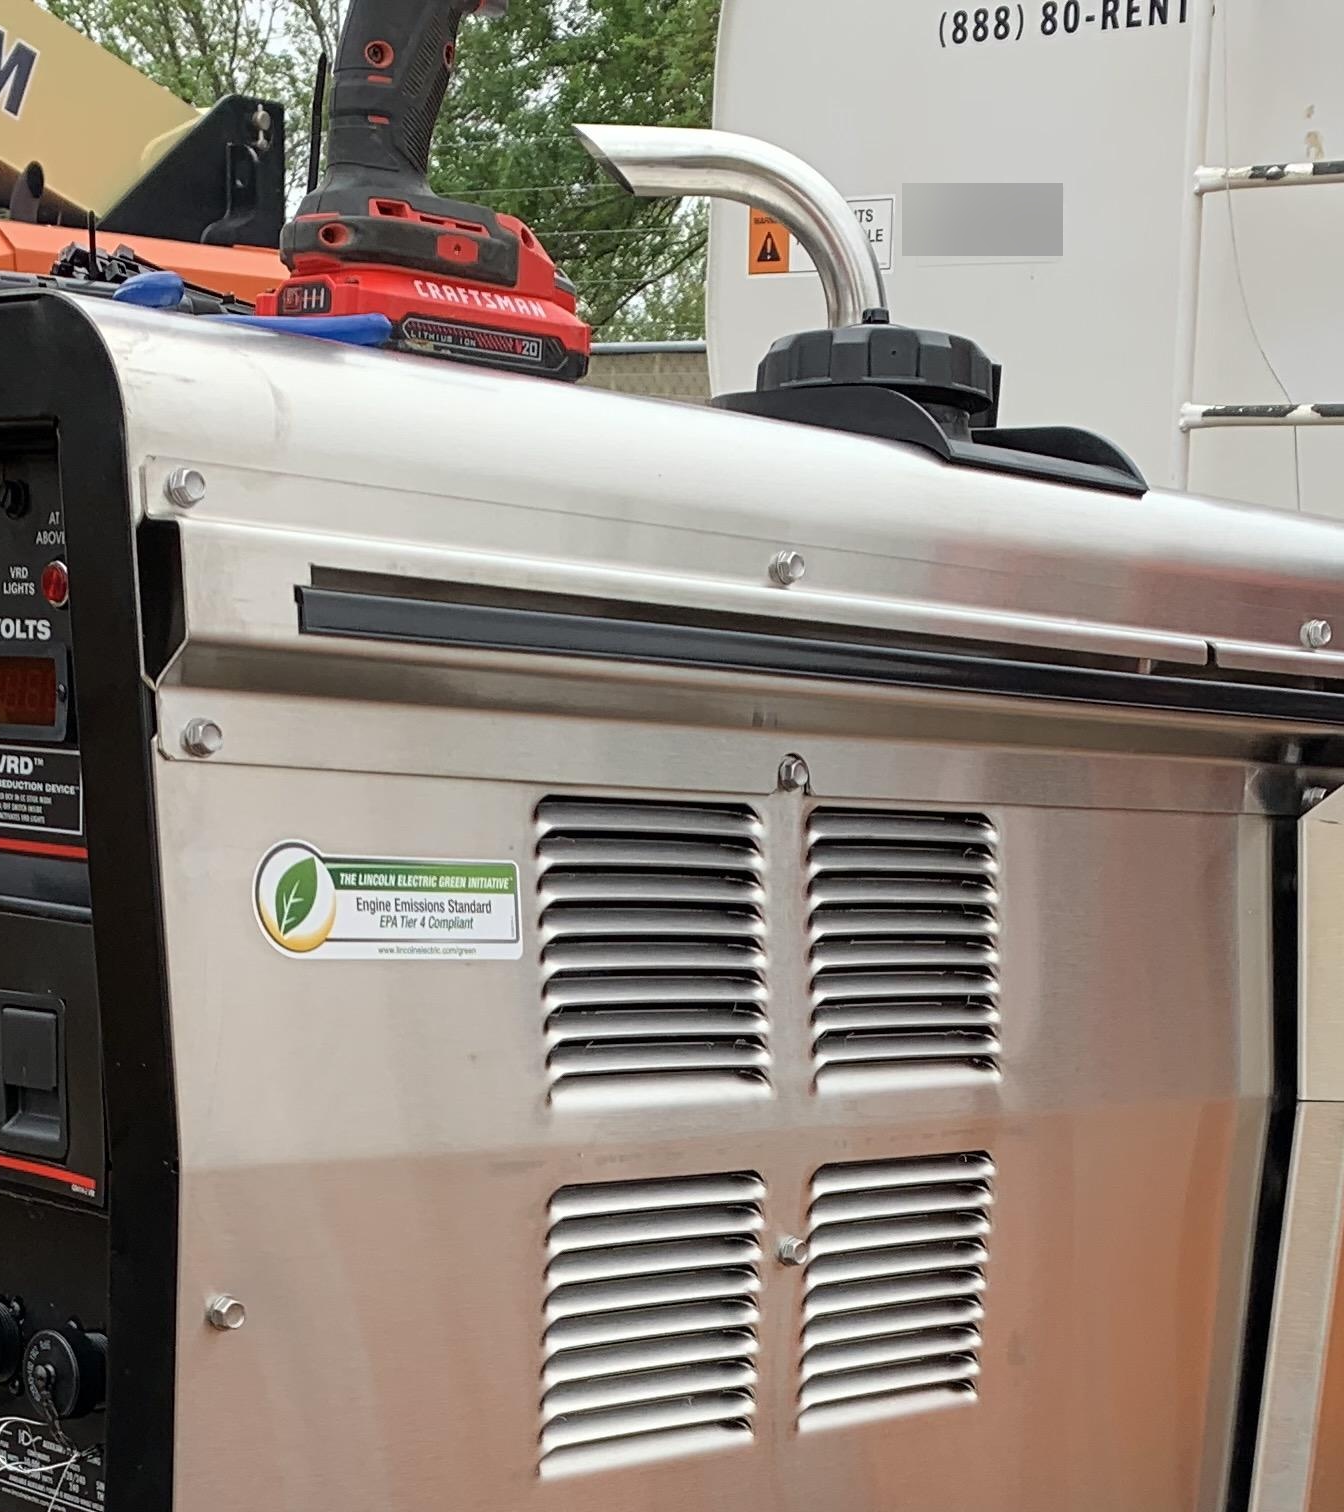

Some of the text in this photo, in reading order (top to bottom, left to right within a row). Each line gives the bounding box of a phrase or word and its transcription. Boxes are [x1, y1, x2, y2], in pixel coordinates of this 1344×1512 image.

[939, 3, 1024, 47] (888)
[413, 279, 547, 319] CRAFTSMAN
[409, 329, 453, 344] LITHIUM
[459, 338, 477, 347] ION
[48, 512, 60, 524] AT
[10, 566, 28, 579] VRD
[3, 582, 35, 595] LIGHTS
[340, 873, 509, 890] THE LINCOLN ELECTRIC GREEN INITIATIVE
[356, 896, 492, 914] Engine Emissions Standard
[379, 916, 474, 932] EPA Tier 4 Compliant
